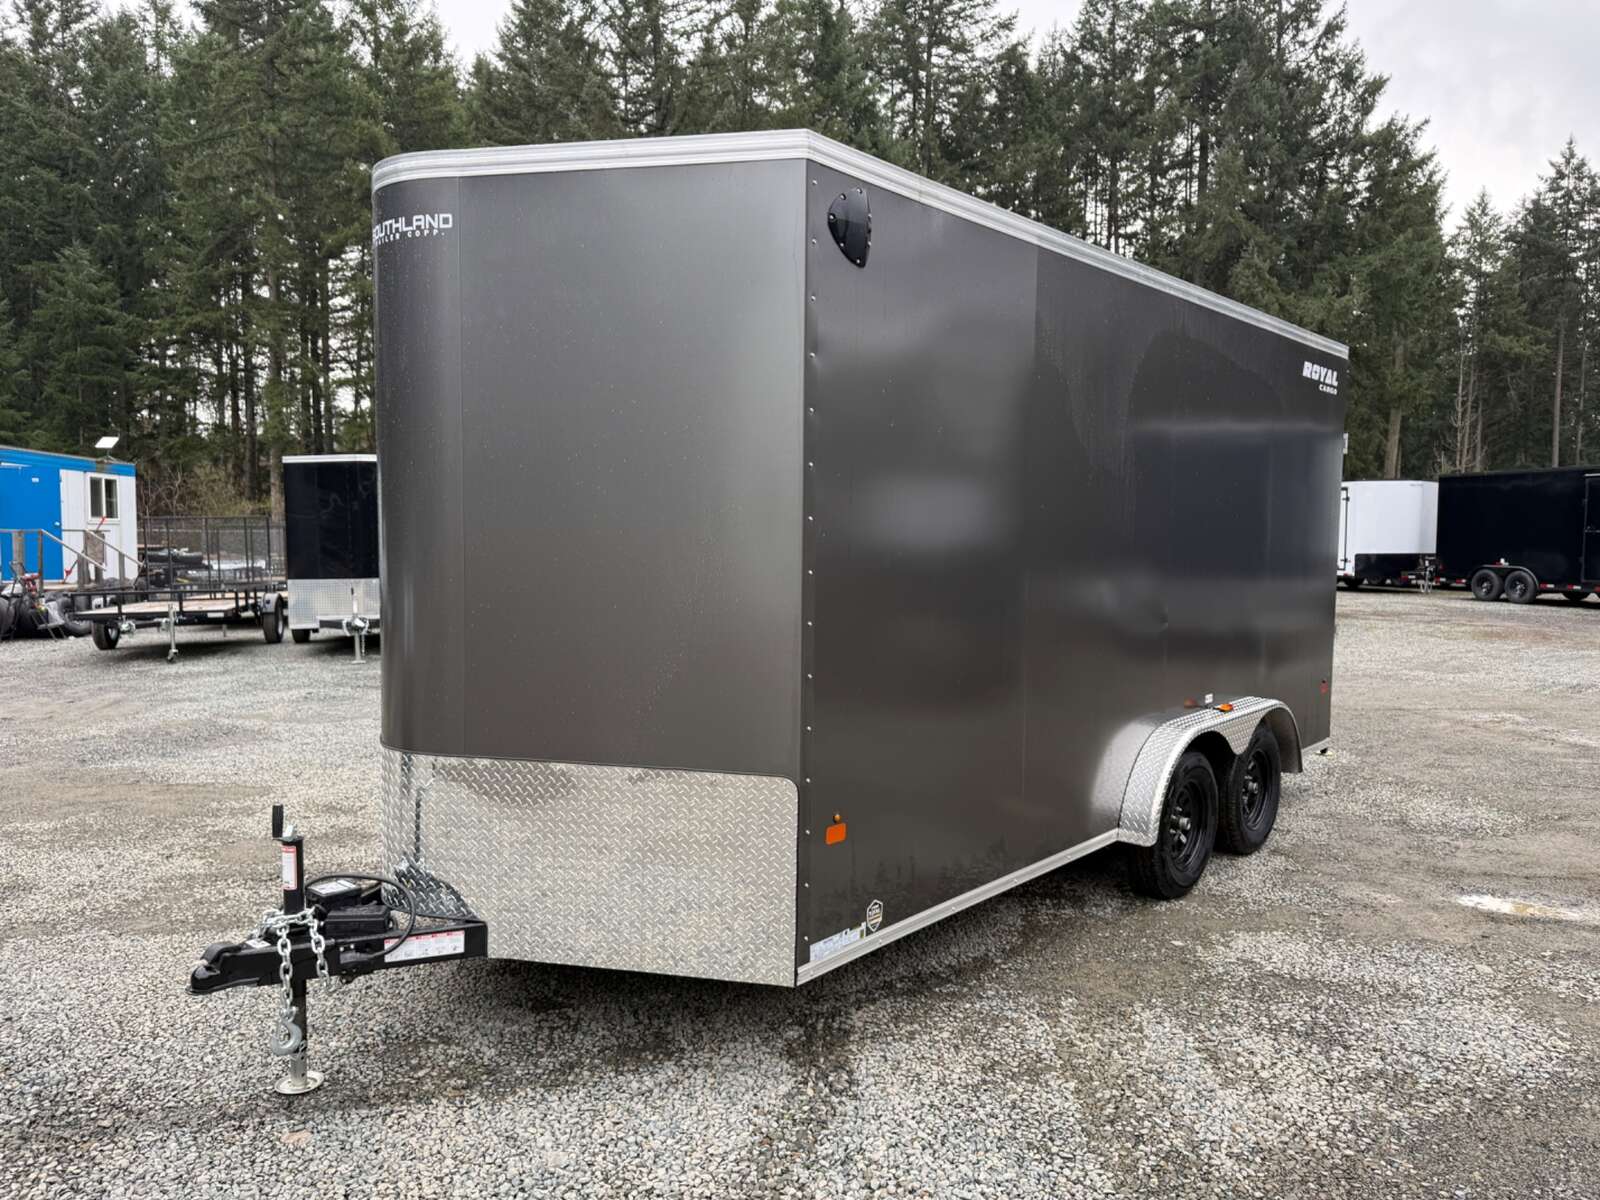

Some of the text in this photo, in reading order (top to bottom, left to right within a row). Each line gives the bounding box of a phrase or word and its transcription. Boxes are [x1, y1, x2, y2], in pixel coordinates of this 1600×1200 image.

[373, 213, 453, 240] OUTHLAND
[1303, 360, 1339, 387] ROYAL
[1319, 384, 1338, 395] CARGO
